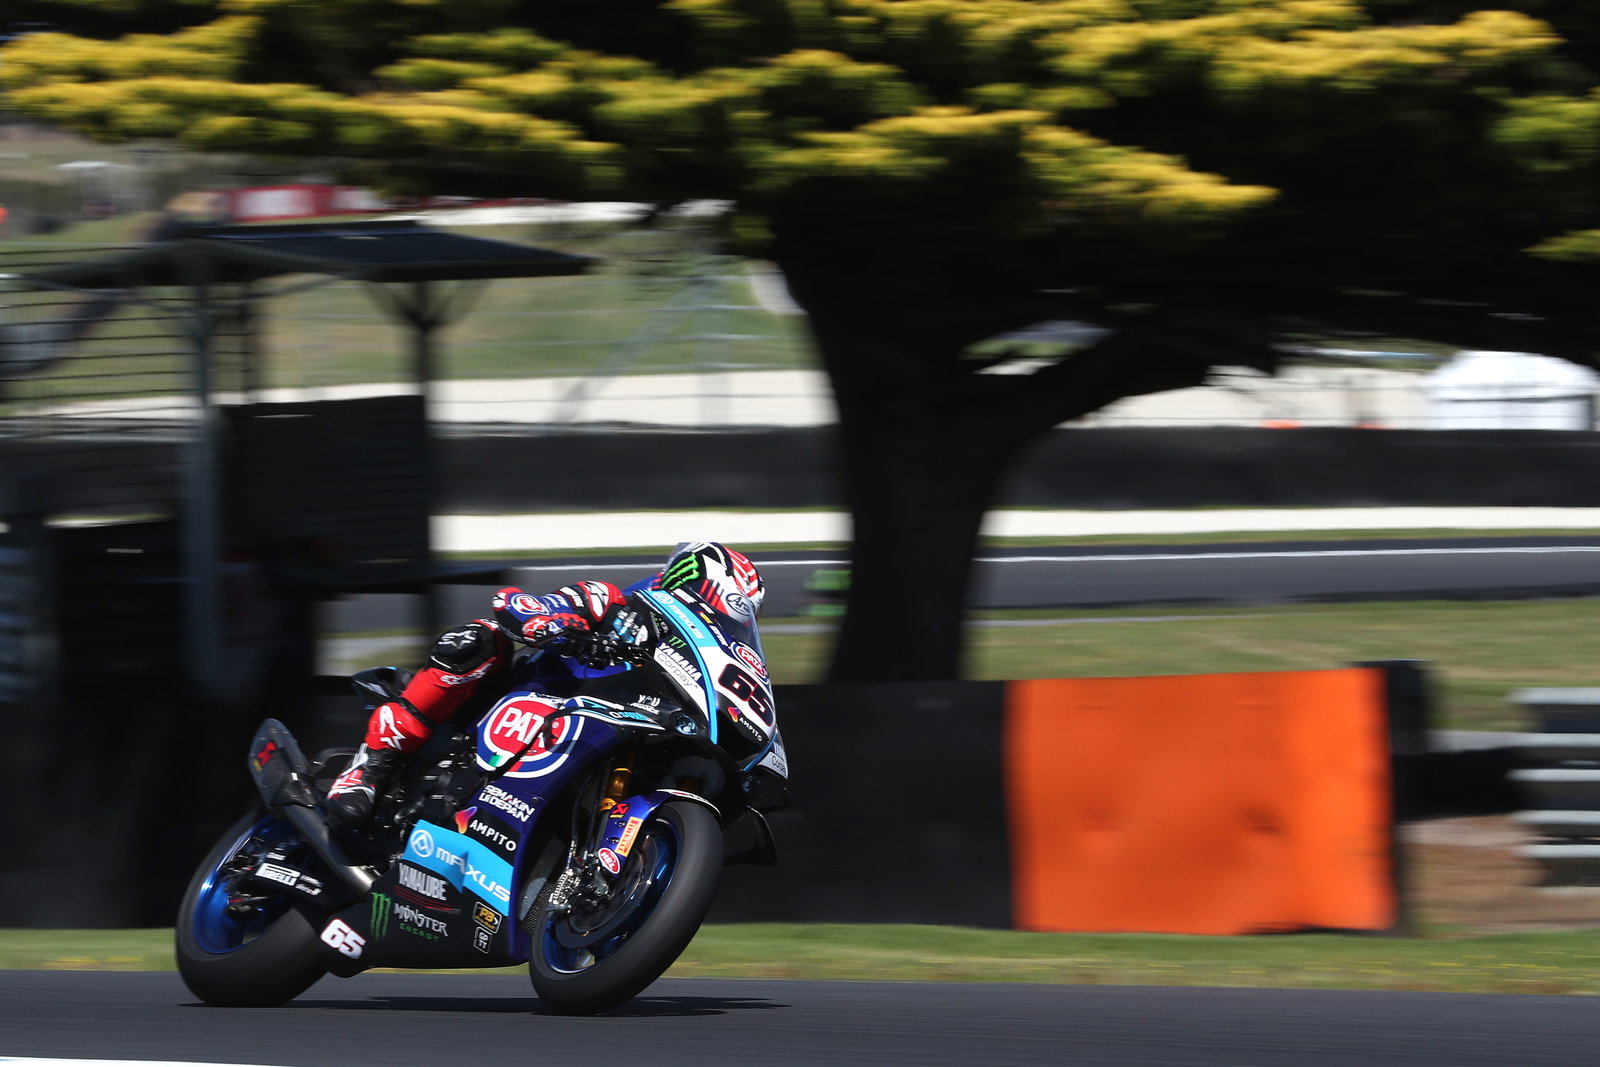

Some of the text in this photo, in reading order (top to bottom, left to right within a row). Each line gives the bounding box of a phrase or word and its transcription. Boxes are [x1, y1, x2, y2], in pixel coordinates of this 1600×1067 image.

[657, 653, 694, 687] Corpay
[658, 642, 702, 682] YAMAHA
[718, 663, 774, 727] 65
[739, 717, 763, 741] AMPITO
[469, 819, 517, 852] AMPITO
[399, 863, 447, 901] YAMALUBE
[435, 847, 511, 902] MAXUS
[321, 919, 366, 958] 65
[394, 903, 448, 937] MONSTER
